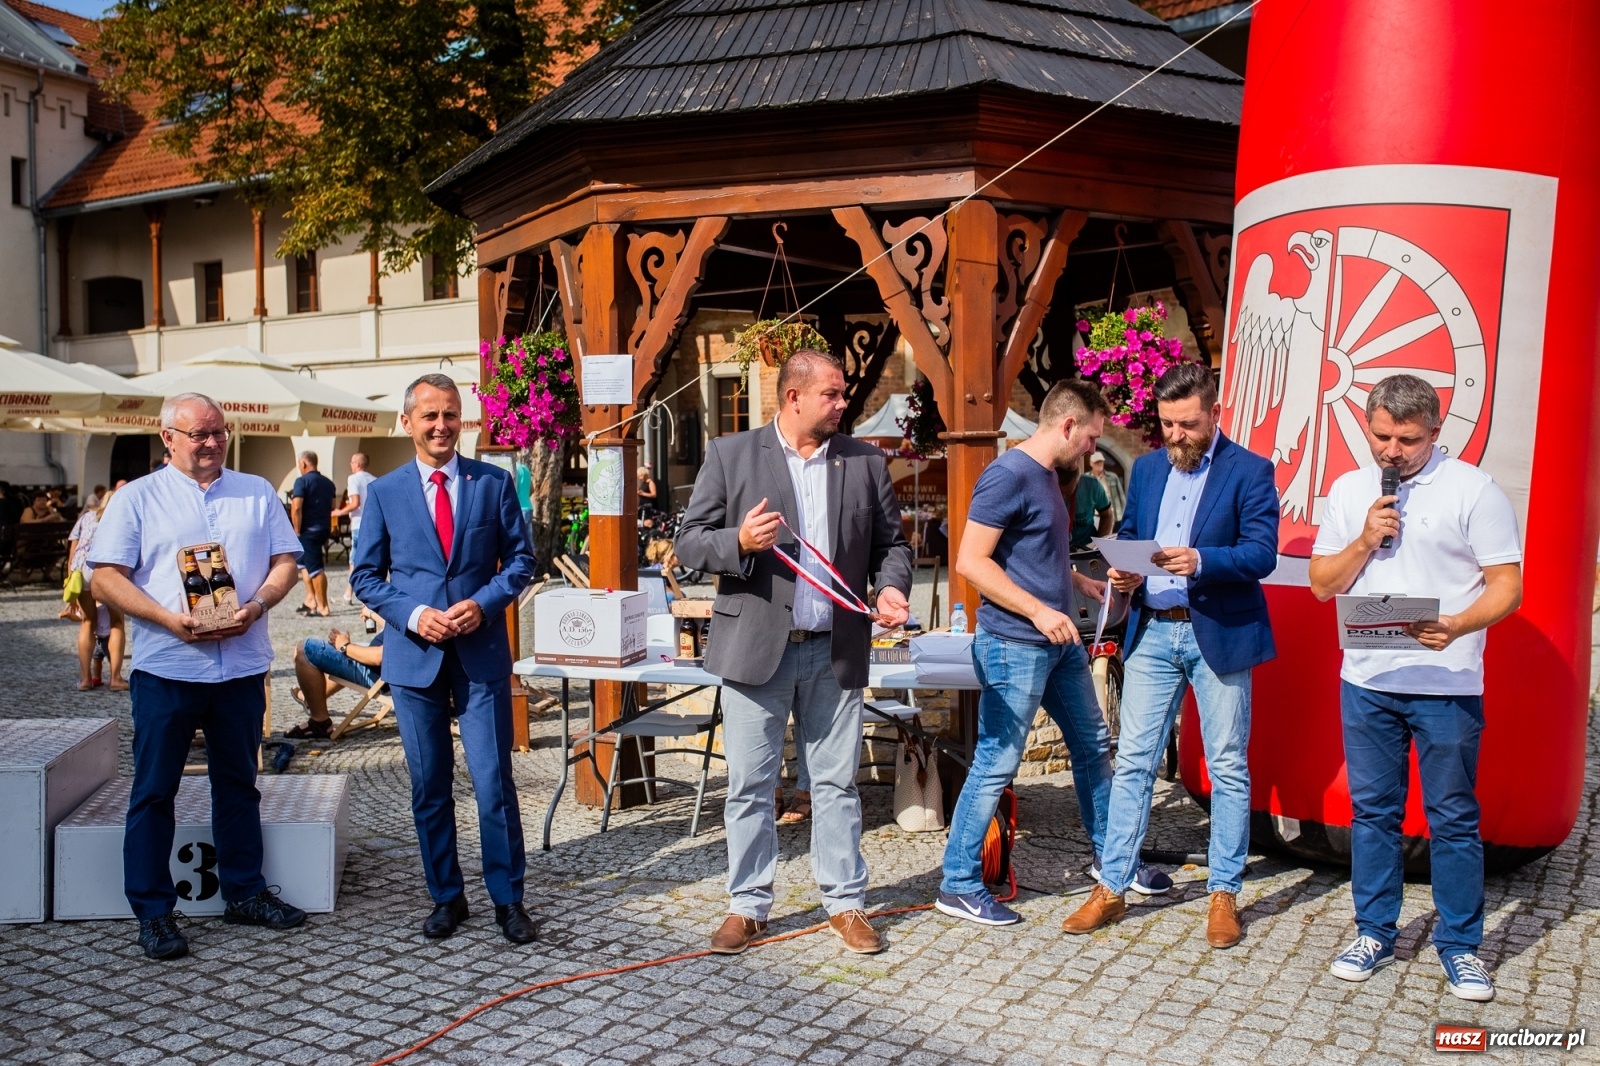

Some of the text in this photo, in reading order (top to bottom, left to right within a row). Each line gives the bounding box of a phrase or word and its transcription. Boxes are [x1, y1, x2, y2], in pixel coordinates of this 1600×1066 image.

[322, 408, 377, 423] RACIBORSKIE
[1347, 629, 1408, 637] POLSK
[175, 842, 219, 901] 3
